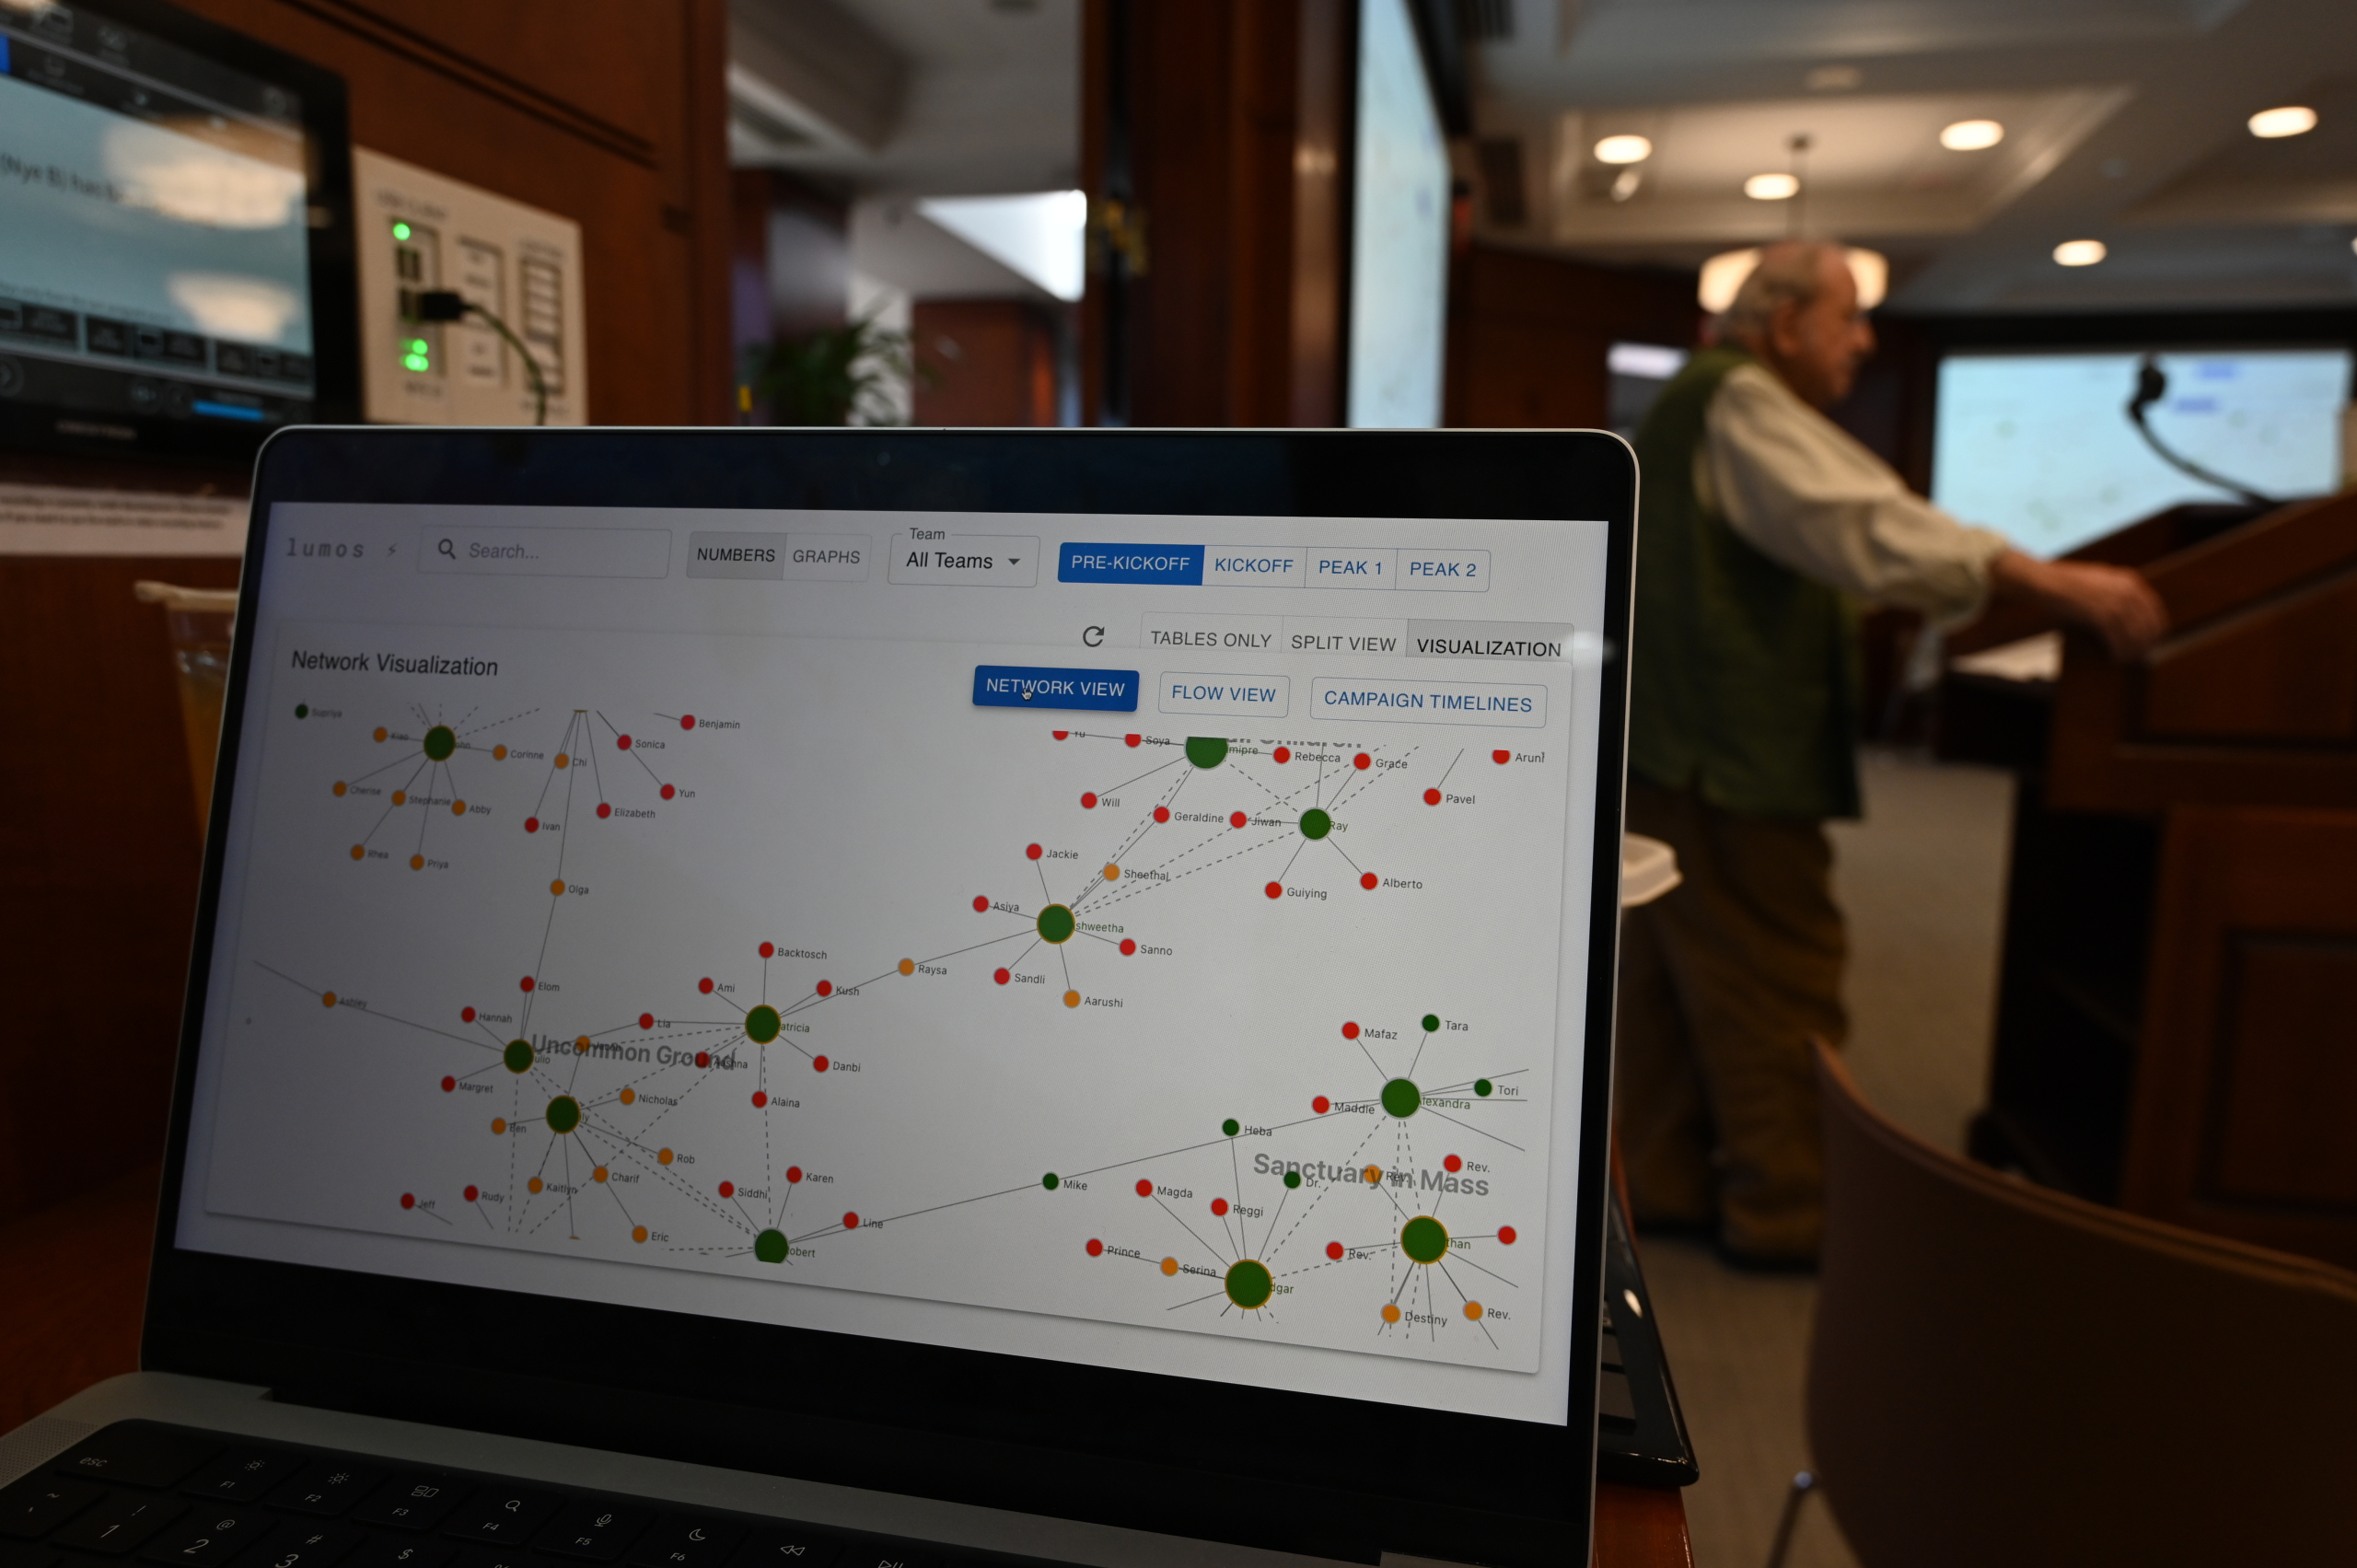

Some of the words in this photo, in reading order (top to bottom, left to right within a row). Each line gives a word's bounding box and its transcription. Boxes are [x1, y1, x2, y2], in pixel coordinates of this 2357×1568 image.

[910, 528, 946, 540] Team
[285, 538, 366, 558] lumos
[469, 542, 540, 560] Search...
[696, 548, 776, 563] NUMBERS
[793, 550, 861, 564] GRAPHS
[906, 552, 928, 568] All
[935, 552, 993, 570] Teams
[1072, 555, 1190, 572] PRE-KICKOFF
[1214, 557, 1295, 575] KICKOFF
[1318, 560, 1368, 575] PEAK
[1375, 562, 1383, 575] 1
[1410, 562, 1459, 577] PEAK
[1467, 563, 1477, 577] 2
[1151, 630, 1217, 646] TABLES
[1224, 632, 1272, 649] ONLY
[1292, 634, 1344, 652] SPLIT
[1348, 636, 1398, 653] VIEW
[1417, 638, 1562, 657] VISUALIZATION
[291, 650, 369, 672] Network
[377, 652, 498, 677] Visualization
[987, 679, 1074, 695] NETWORK
[1081, 682, 1125, 696] VIEW
[1172, 686, 1225, 701] FLOW
[1230, 687, 1276, 703] VIEW
[1324, 691, 1424, 709] CAMPAIGN
[1430, 693, 1533, 714] TIMELINES
[699, 719, 740, 729] Benjamin
[456, 741, 470, 749] ohn
[635, 739, 665, 749] Sonica
[1145, 736, 1170, 747] Soya
[510, 749, 544, 760] Corinne
[1228, 746, 1259, 756] mipre
[573, 758, 586, 767] Chi
[1295, 752, 1341, 763] Rebecca
[1376, 759, 1408, 770] Grace
[350, 785, 381, 796] Cherise
[679, 789, 695, 798] Yun
[409, 796, 451, 807] Stephanie
[1101, 797, 1120, 807] Will
[1446, 794, 1476, 805] Pavel
[469, 805, 492, 815] Abby
[614, 808, 656, 819] Elizabeth
[1174, 812, 1225, 823] Geraldine
[1251, 817, 1282, 828] Jiwan
[542, 822, 561, 831] Ivan
[368, 850, 389, 859] Rhea
[1047, 849, 1079, 860] Jackie
[427, 860, 448, 870] Priya
[1382, 877, 1423, 889] Alberto
[568, 885, 589, 895] Olga
[1286, 887, 1328, 900] Guiying
[993, 901, 1020, 912] Asiya
[1075, 921, 1124, 934] shweetha
[777, 947, 828, 959] Backtosch
[1140, 945, 1173, 956] Sanno
[918, 965, 947, 976] Raysa
[1014, 973, 1046, 984] Sandli
[538, 981, 561, 992] Elom
[717, 983, 736, 993] Ami
[835, 986, 860, 996] Kush
[1084, 996, 1123, 1008] Aarushi
[479, 1013, 513, 1024] Hannah
[657, 1019, 671, 1028] Lia
[781, 1023, 810, 1033] atricia
[1445, 1020, 1469, 1031] Tara
[1364, 1028, 1399, 1040] Mafaz
[531, 1033, 651, 1063] Uncommon
[656, 1045, 737, 1071] Ground
[534, 1055, 552, 1064] ulio
[832, 1061, 861, 1072] Danbi
[459, 1082, 493, 1094] Margret
[1497, 1085, 1519, 1096] Tori
[638, 1094, 679, 1106] Nicholas
[772, 1097, 800, 1108] Alaina
[1334, 1102, 1376, 1114] Maddie
[509, 1124, 527, 1133] Ben
[1244, 1125, 1272, 1136] Heba
[677, 1154, 695, 1165] Rob
[1467, 1161, 1490, 1172] Rev.
[611, 1172, 640, 1183] Charif
[806, 1172, 834, 1184] Karen
[1253, 1153, 1385, 1190] Sanctuary
[1391, 1165, 1413, 1190] in
[1421, 1168, 1490, 1196] Mass
[546, 1182, 577, 1195] Kaitlyn
[1063, 1179, 1088, 1191] Mike
[1306, 1178, 1321, 1189] Dr.
[482, 1191, 505, 1204] Rudy
[738, 1188, 768, 1200] Siddhi
[1157, 1186, 1193, 1199] Magda
[420, 1200, 435, 1209] Jeff
[1233, 1204, 1264, 1218] Reggi
[863, 1218, 884, 1229] Line
[651, 1232, 669, 1242] Eric
[1446, 1238, 1471, 1249] than
[789, 1248, 816, 1258] obert
[1107, 1246, 1141, 1258] Prince
[1348, 1249, 1372, 1260] Rev.
[1182, 1264, 1216, 1277] Serina
[1270, 1283, 1295, 1295] dgar
[1487, 1307, 1511, 1320] Rev.
[1405, 1311, 1447, 1328] Destiny
[80, 1457, 108, 1467] esc
[220, 1481, 235, 1489] F1
[305, 1493, 322, 1503] F2
[131, 1504, 147, 1516] !
[392, 1507, 410, 1516] F3
[216, 1519, 236, 1530] @
[482, 1522, 500, 1531] F4
[100, 1524, 121, 1539] 1
[306, 1534, 323, 1545] #
[575, 1537, 592, 1548] F5
[183, 1539, 210, 1554] 2
[275, 1553, 299, 1568] 3
[398, 1549, 413, 1561] $
[669, 1551, 686, 1562] F6
